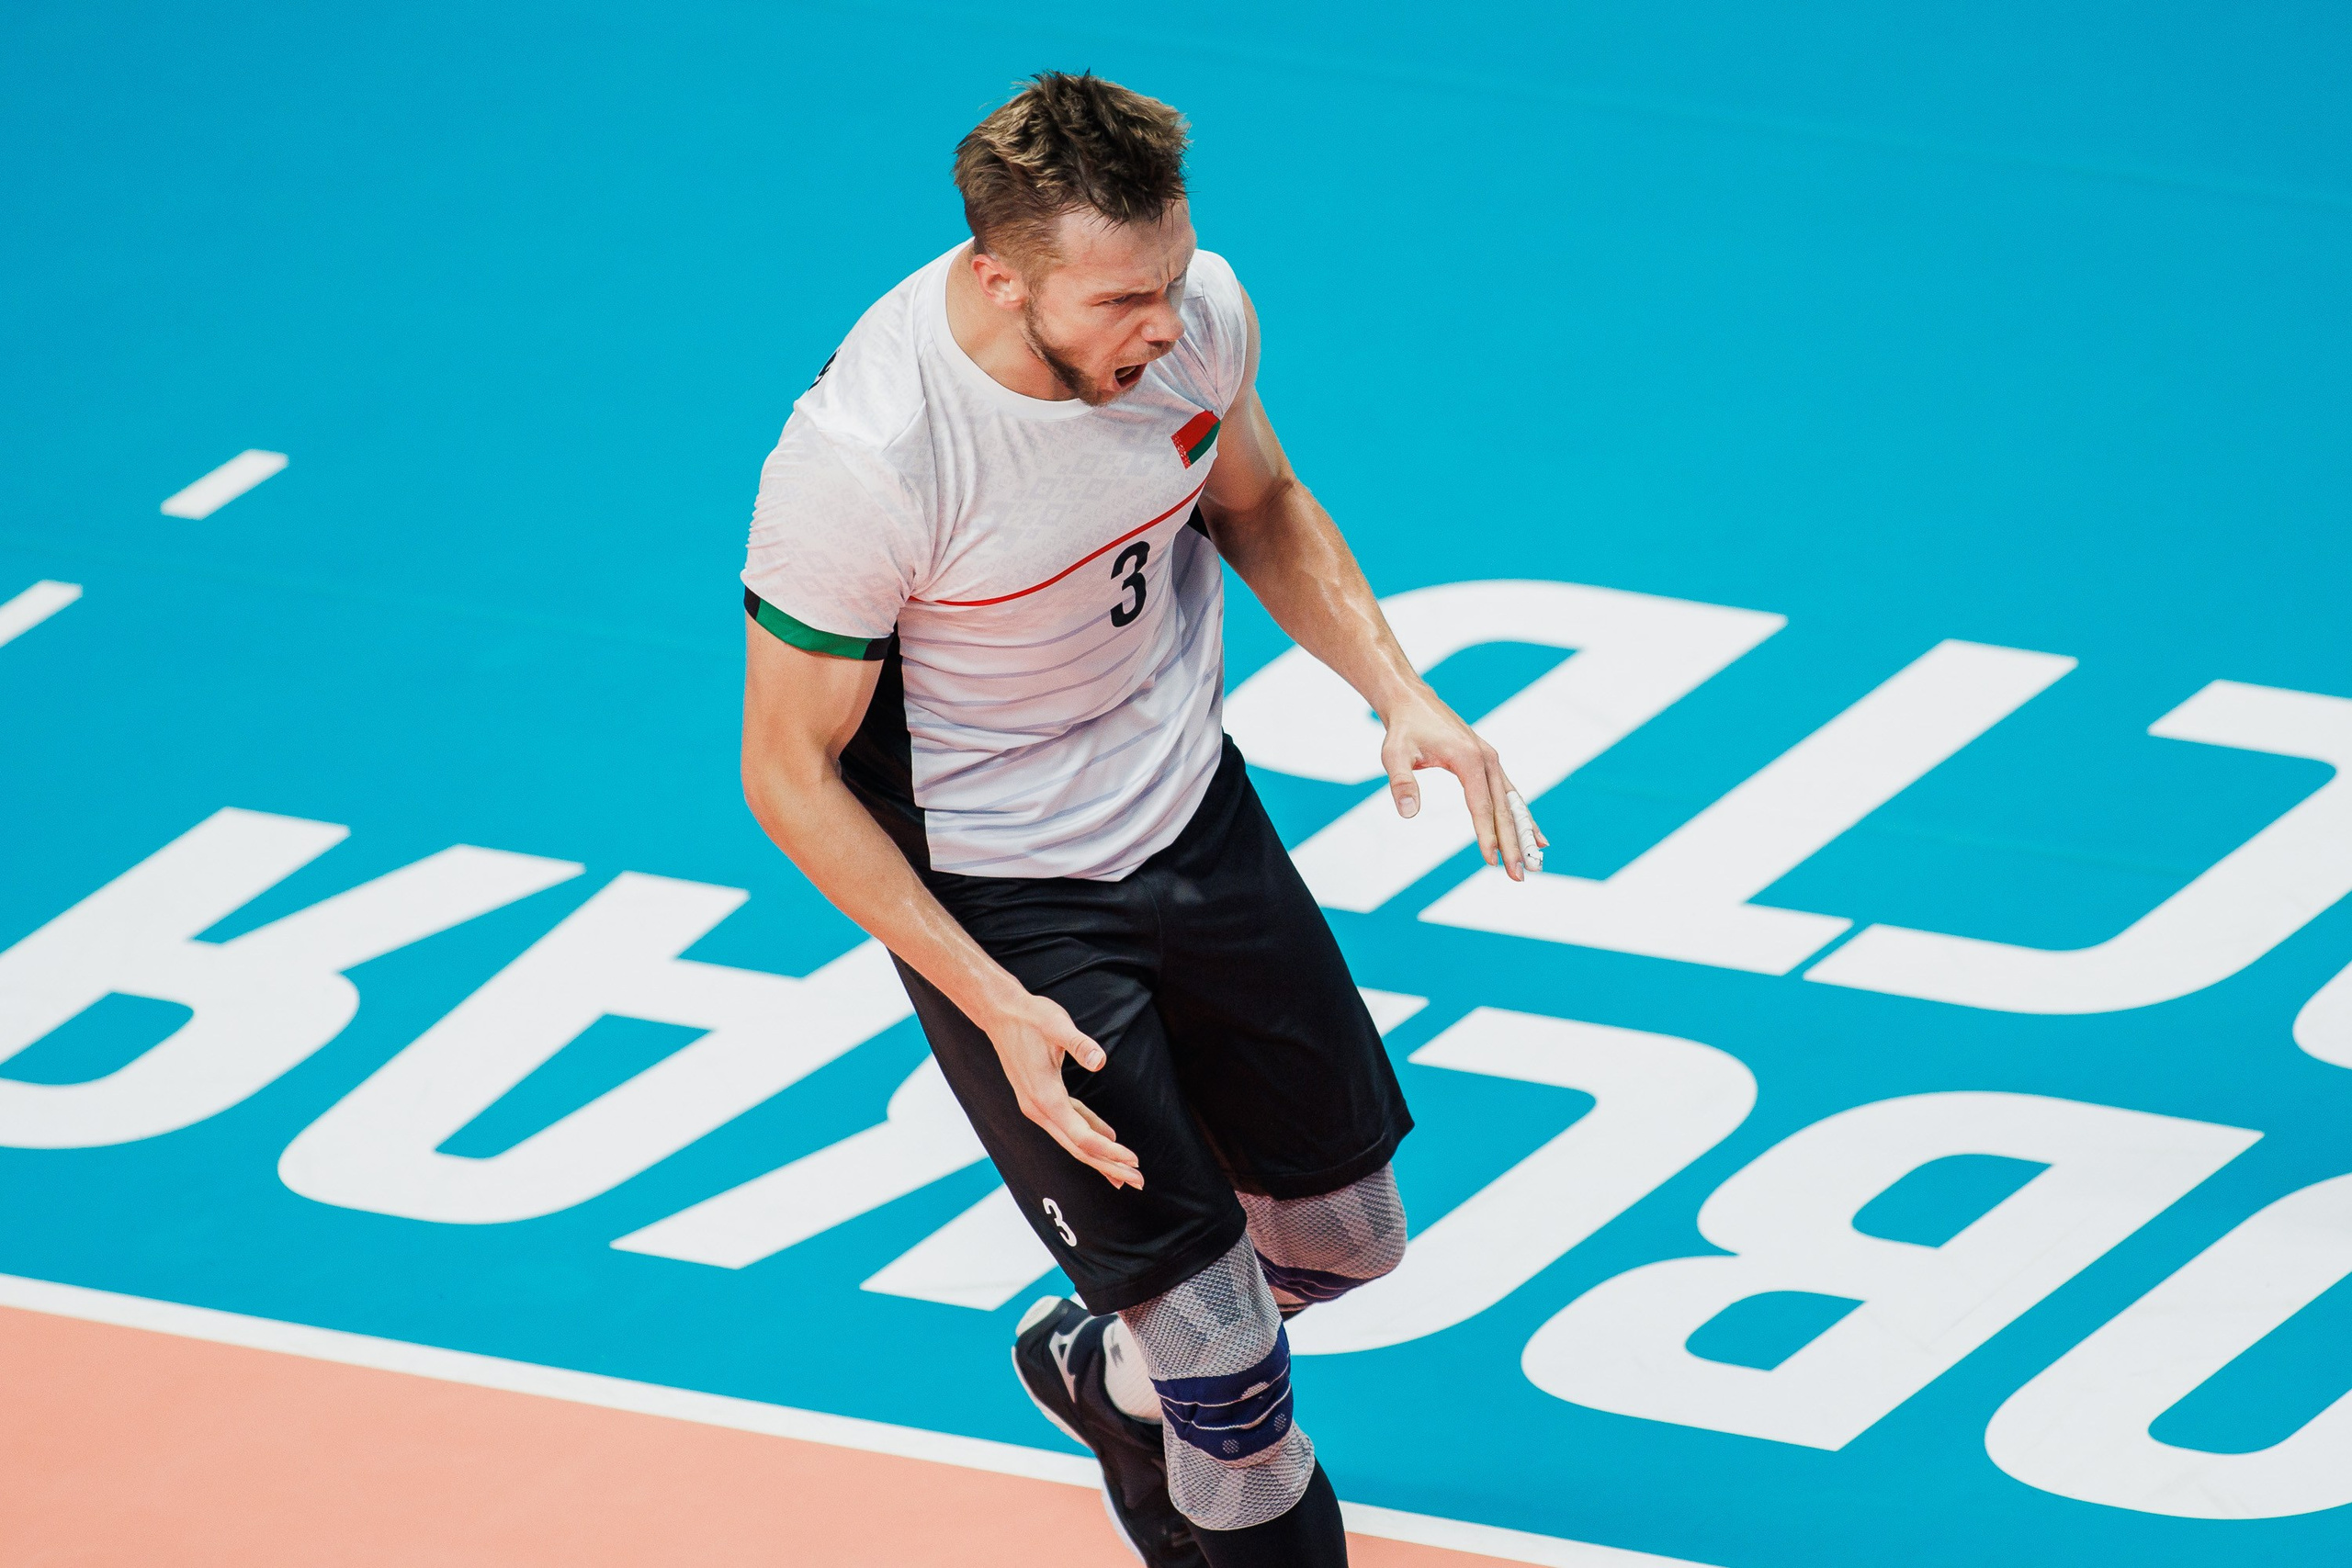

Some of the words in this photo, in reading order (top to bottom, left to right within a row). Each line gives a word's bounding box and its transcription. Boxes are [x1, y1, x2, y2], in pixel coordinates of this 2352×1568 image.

[1110, 540, 1151, 627] 3
[1226, 579, 2352, 1069] СТЬ
[1042, 1197, 1078, 1247] 3
